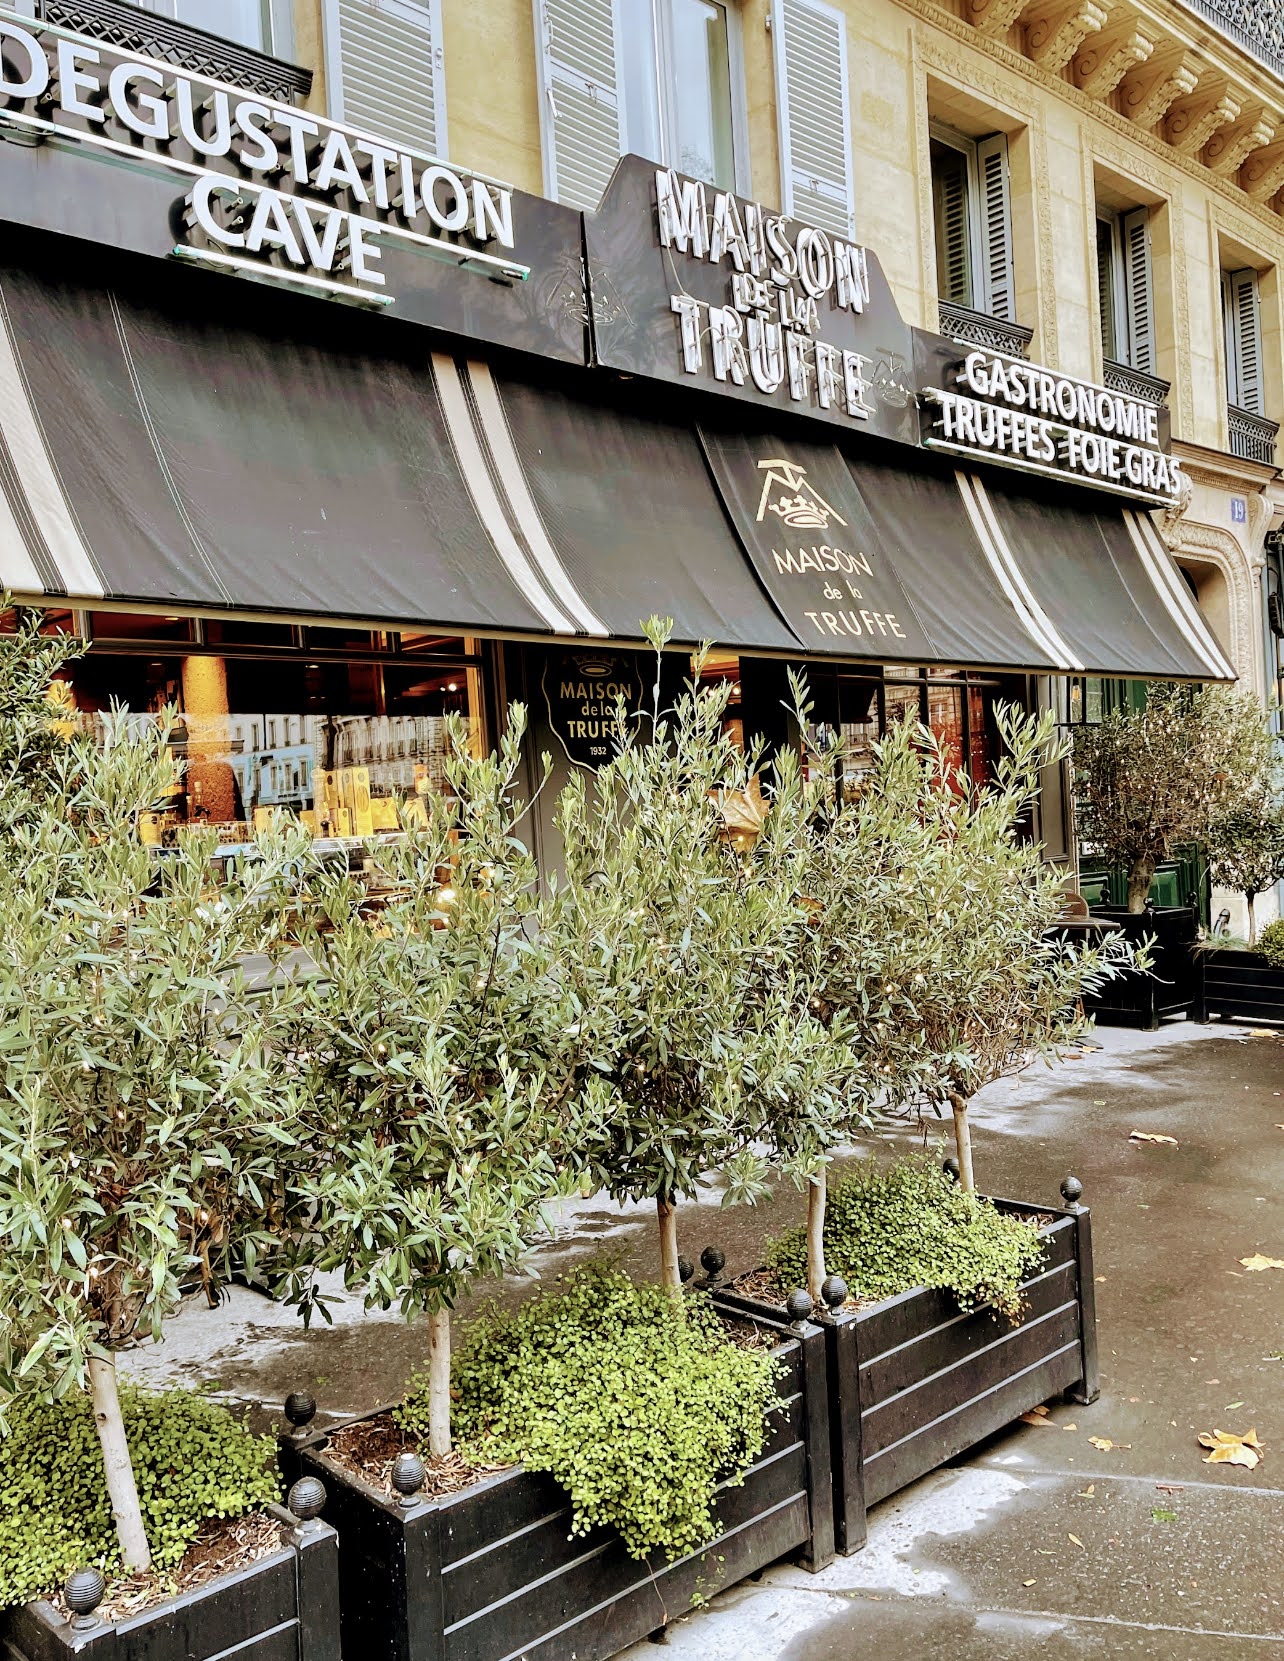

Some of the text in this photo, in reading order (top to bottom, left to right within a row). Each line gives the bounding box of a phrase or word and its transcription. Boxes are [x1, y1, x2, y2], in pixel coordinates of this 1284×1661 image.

[0, 22, 515, 249] DEGUSTATION
[193, 174, 387, 285] CAVE
[655, 168, 869, 314] MAISON
[671, 295, 876, 420] TRUFFE
[965, 351, 1159, 447] GASTRONOMIE
[936, 390, 1182, 495] TRUFFES FOIE GRAS
[1234, 501, 1244, 520] 19
[771, 545, 874, 577] MAISON
[823, 579, 863, 600] de la
[804, 609, 907, 639] TRUFFE
[560, 681, 632, 700] MAISON
[581, 701, 614, 716] de la
[567, 720, 626, 738] TRUFF
[589, 746, 607, 756] 1932
